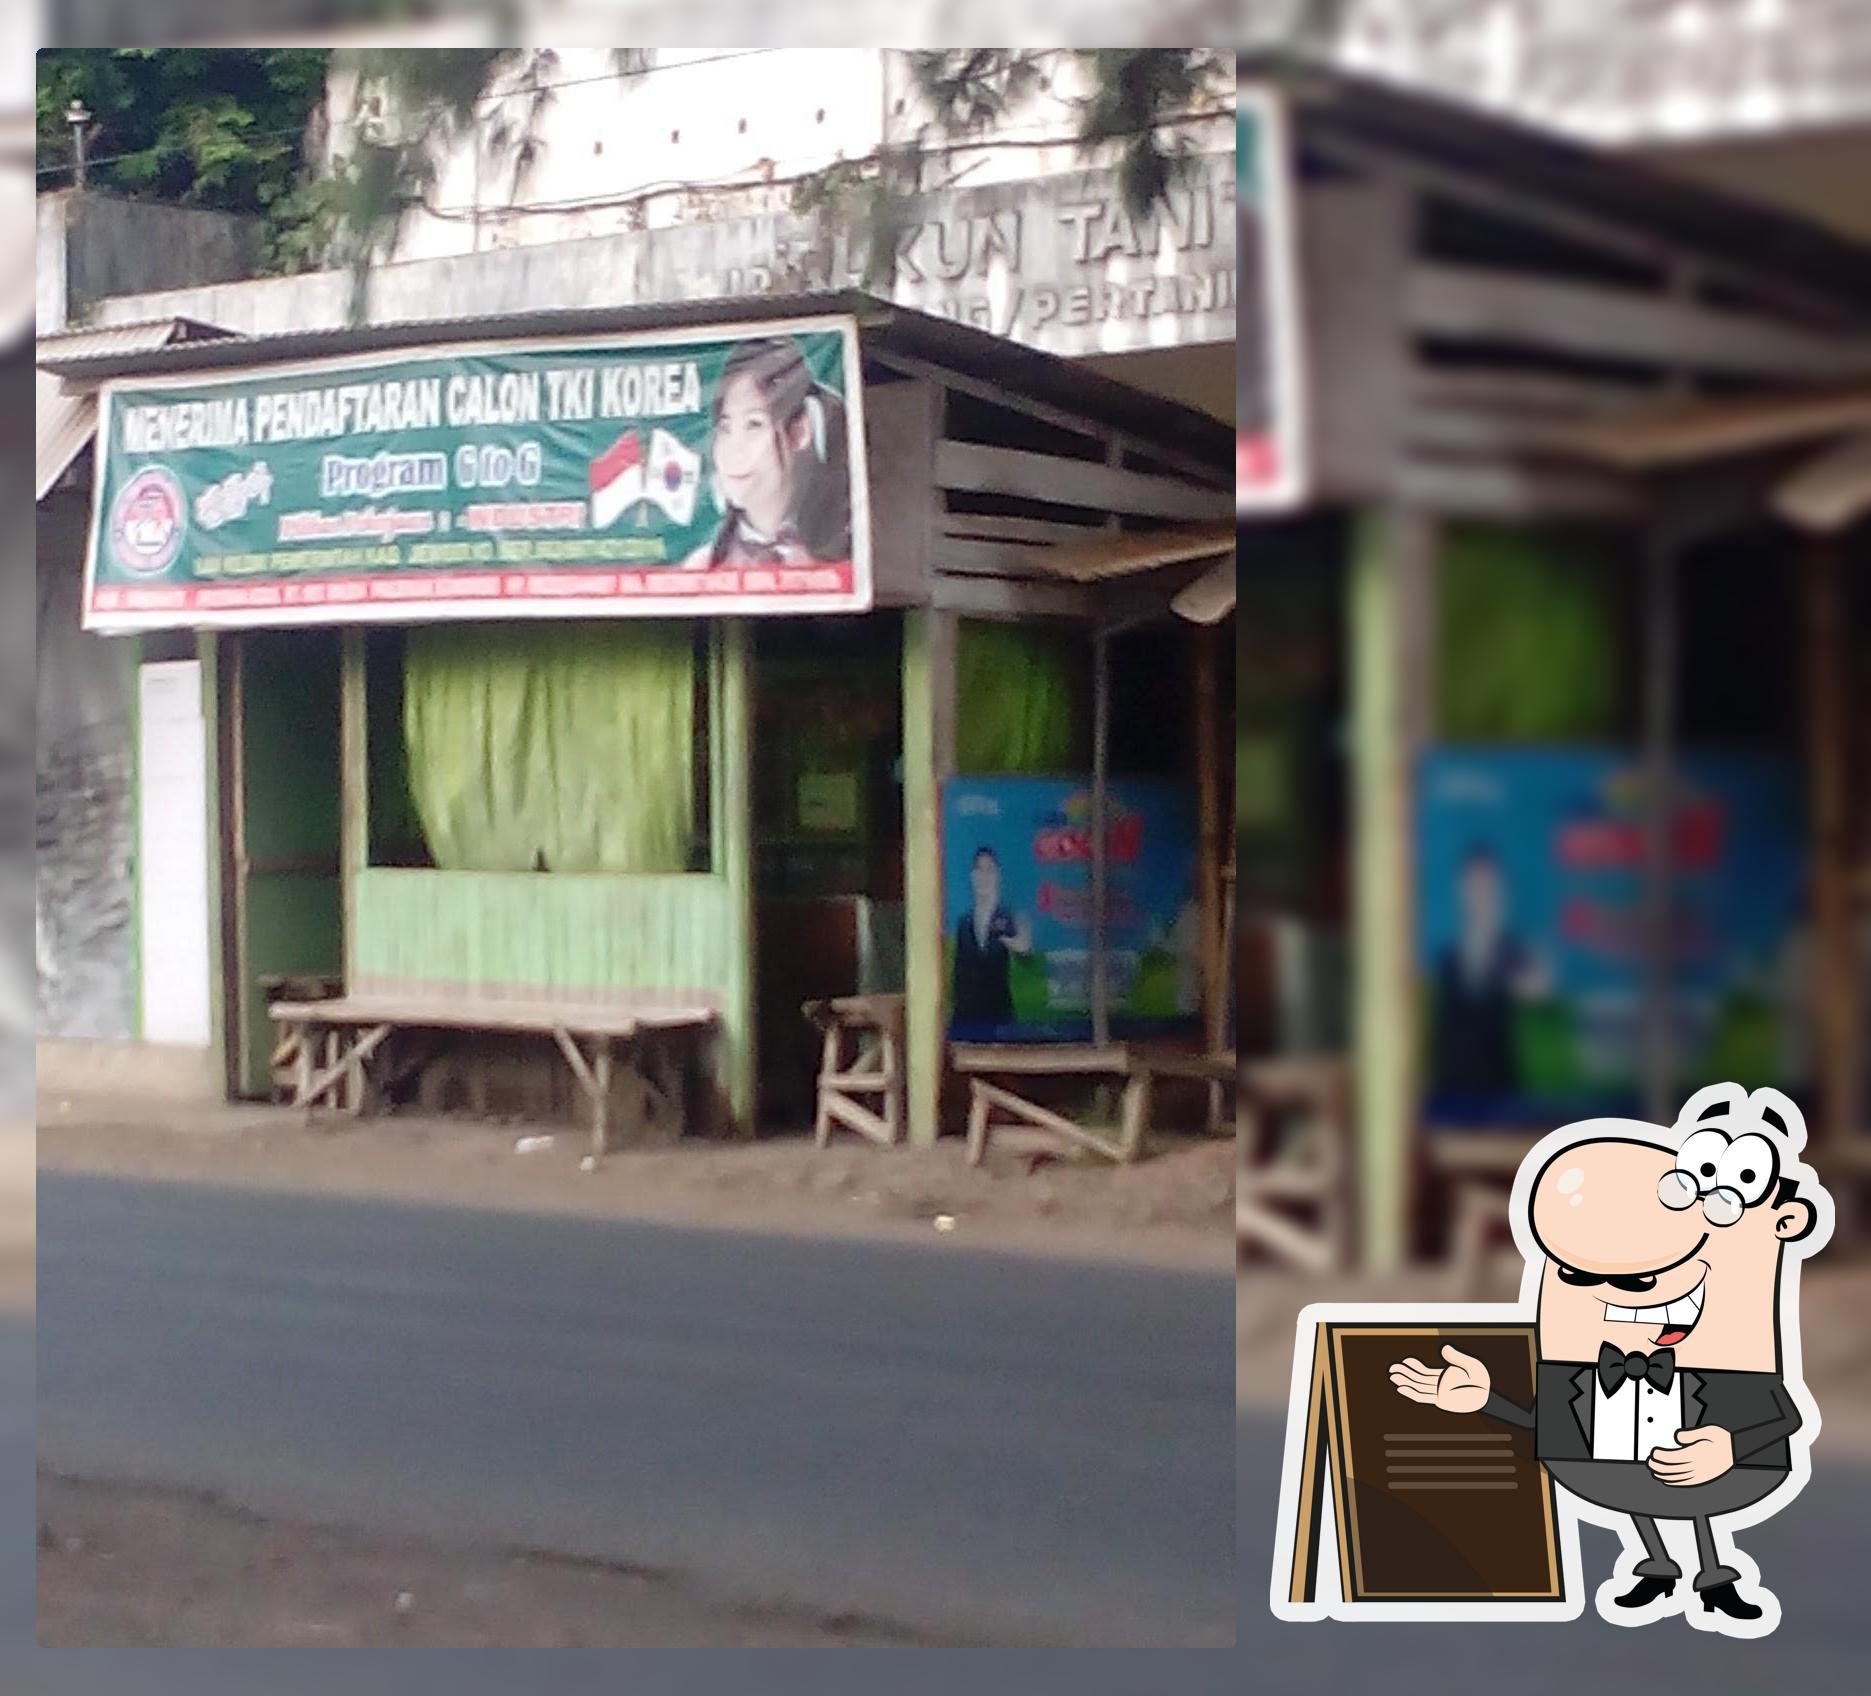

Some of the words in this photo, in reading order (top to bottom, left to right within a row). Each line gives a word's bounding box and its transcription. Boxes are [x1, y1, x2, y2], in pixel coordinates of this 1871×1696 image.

[1054, 178, 1237, 264] TANI
[253, 377, 442, 442] PENDAFTARAN
[447, 371, 540, 427] CALON
[544, 367, 596, 420] TKI
[600, 361, 701, 419] KOREA
[321, 453, 447, 497] Program
